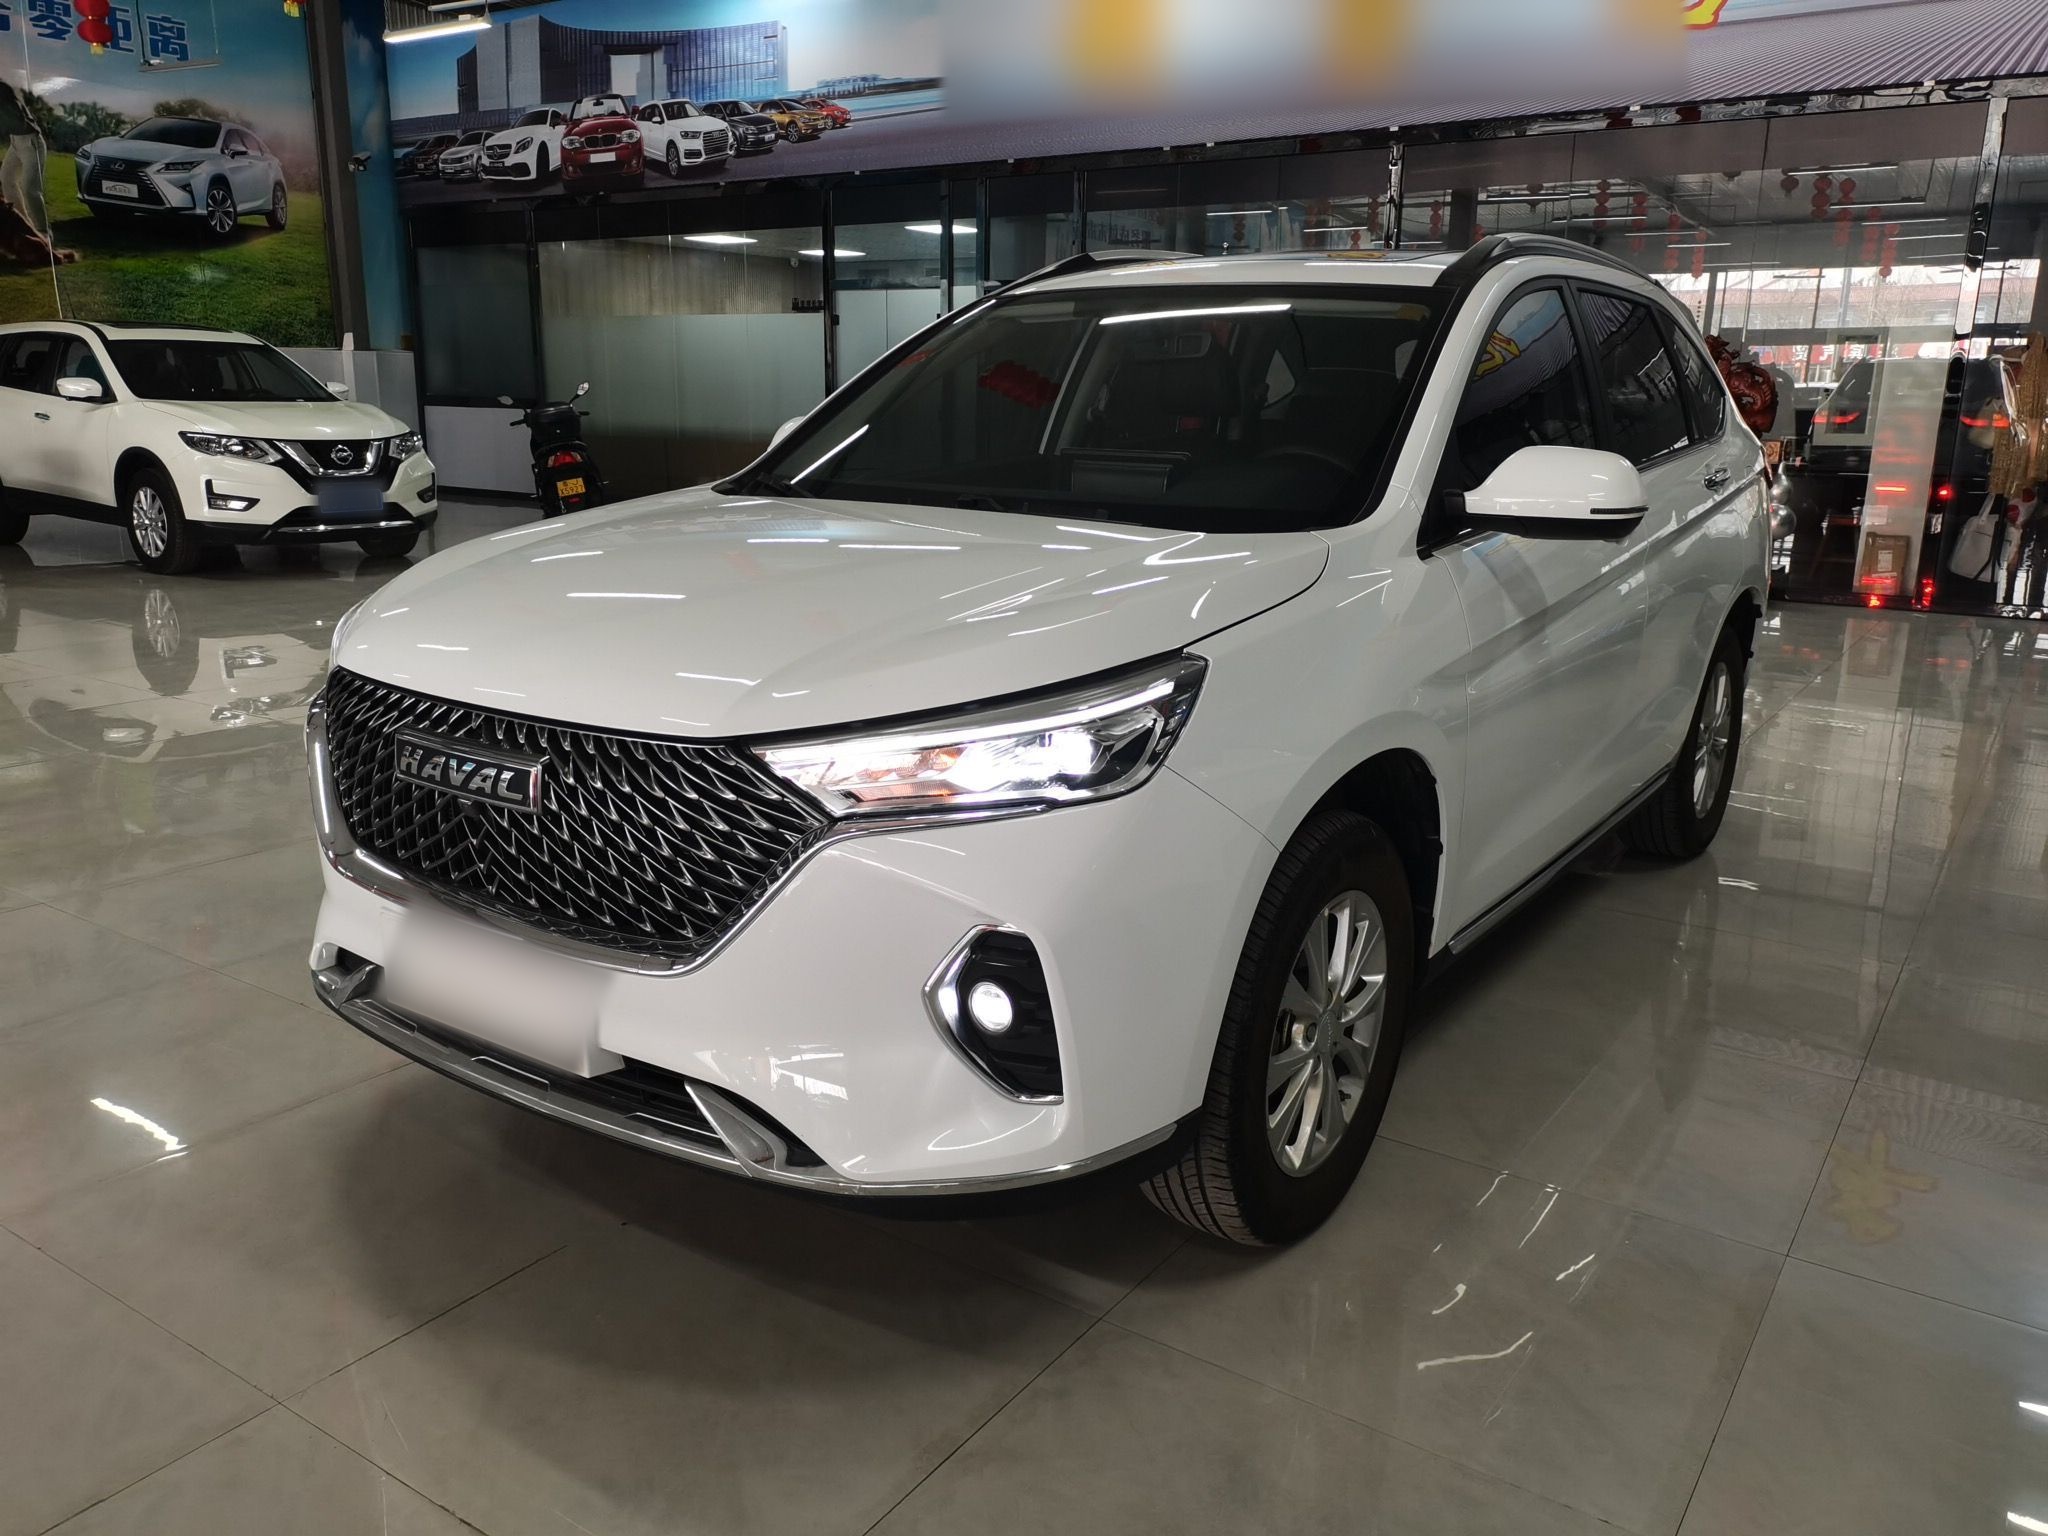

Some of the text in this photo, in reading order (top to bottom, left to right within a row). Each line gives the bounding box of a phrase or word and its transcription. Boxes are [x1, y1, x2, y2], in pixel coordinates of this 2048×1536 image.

[0, 0, 189, 61] 零距离
[400, 745, 523, 800] HAVAL
